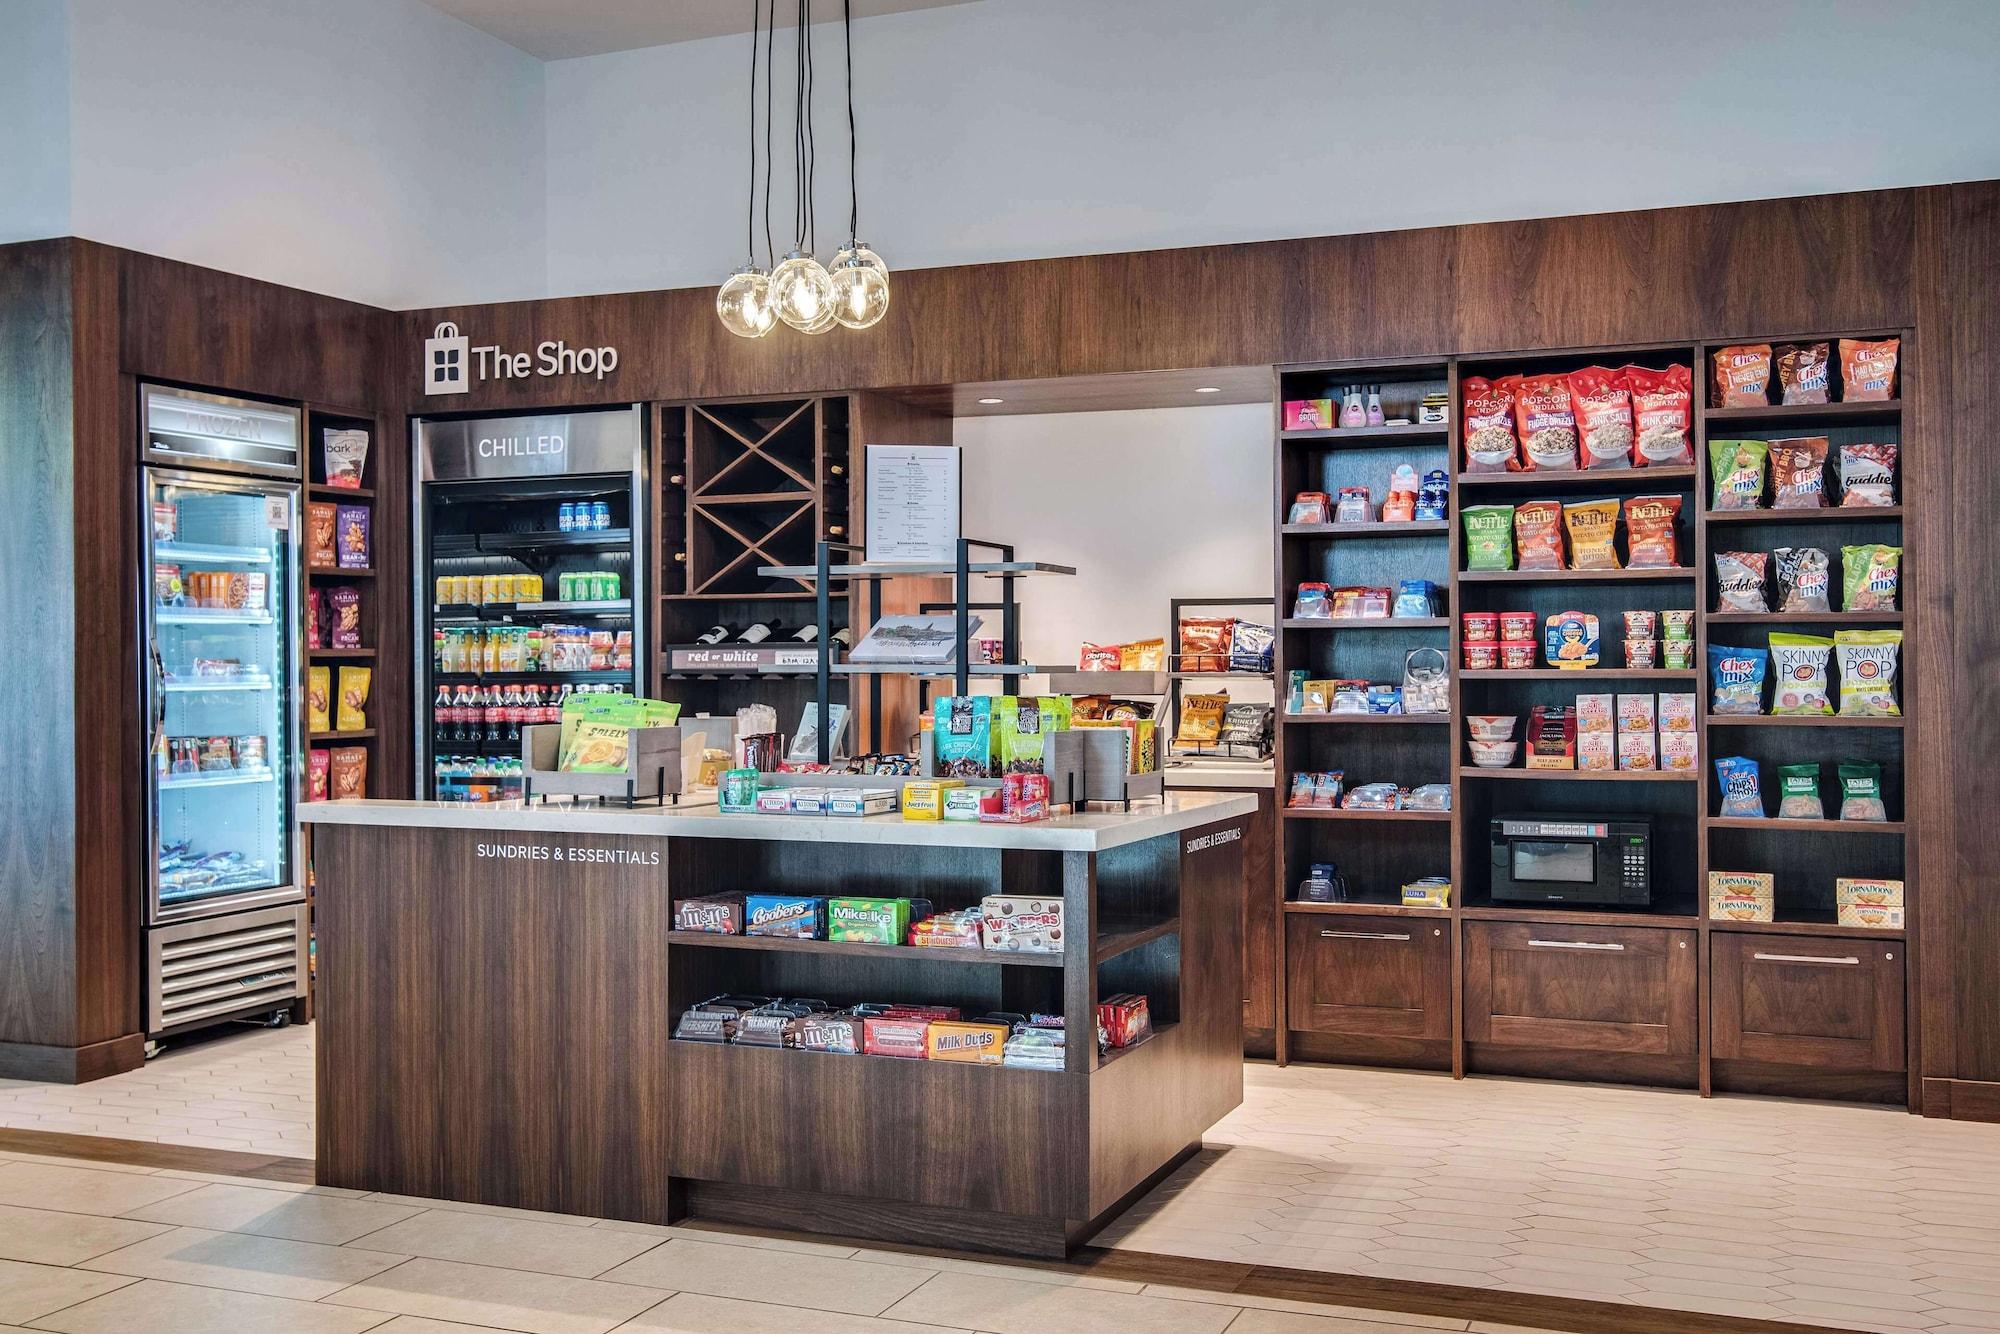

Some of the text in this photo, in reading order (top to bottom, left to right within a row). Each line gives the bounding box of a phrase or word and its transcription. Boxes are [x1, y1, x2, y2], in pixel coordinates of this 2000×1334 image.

[471, 341, 618, 381] The Shop
[1732, 354, 1761, 367] Chex
[1856, 349, 1888, 362] Chex
[1797, 362, 1827, 382] Chex
[1741, 381, 1762, 393] mix
[1801, 376, 1827, 391] mix
[1865, 378, 1888, 391] mix
[1467, 395, 1515, 408] POPCORN
[1579, 390, 1631, 404] POPCORN
[1634, 392, 1688, 403] POPCORN
[1644, 399, 1679, 409] INDIANA
[1477, 403, 1509, 413] INDIANA
[1299, 413, 1319, 421] SPORT
[1468, 416, 1513, 429] FUDGE DRIZZLE
[1528, 418, 1549, 429] FUDGE
[1589, 412, 1629, 426] PINK SALT
[1642, 415, 1682, 426] PINK SALT
[186, 410, 264, 441] FROZEN
[326, 444, 352, 454] bark
[479, 436, 564, 457] CHILLED
[1782, 448, 1793, 466] BBQ
[1731, 469, 1761, 482] Chex
[1792, 466, 1823, 485] Chex
[1845, 472, 1893, 487] buddie
[1733, 478, 1759, 493] mix
[1796, 479, 1822, 494] mix
[1583, 553, 1606, 561] DIJON
[1797, 571, 1827, 587] Chex
[1869, 567, 1897, 581] Chex
[1801, 584, 1826, 598] mix
[1870, 577, 1897, 592] mix
[688, 651, 709, 662] red
[723, 650, 759, 662] white
[1720, 658, 1757, 672] Chex
[1782, 663, 1825, 681] POP
[1846, 659, 1892, 679] POP
[1724, 671, 1753, 684] mix
[1846, 679, 1889, 687] POPCORN
[1228, 717, 1258, 725] KRINKLE
[589, 727, 628, 738] SOLELY
[1727, 778, 1752, 793] Chips
[1186, 827, 1241, 854] SUNDRIES & ESSENTIALS
[477, 844, 660, 865] SUNDRIES & ESSENTIALS
[1405, 890, 1425, 898] LUNA
[752, 902, 807, 924] Goobers
[834, 907, 891, 923] Mike Ike
[989, 913, 1060, 931] WHOPPERS
[681, 1020, 722, 1031] HERSHEY'S
[747, 1017, 788, 1029] HERSHEY'S
[937, 1032, 994, 1050] Milk Duds
